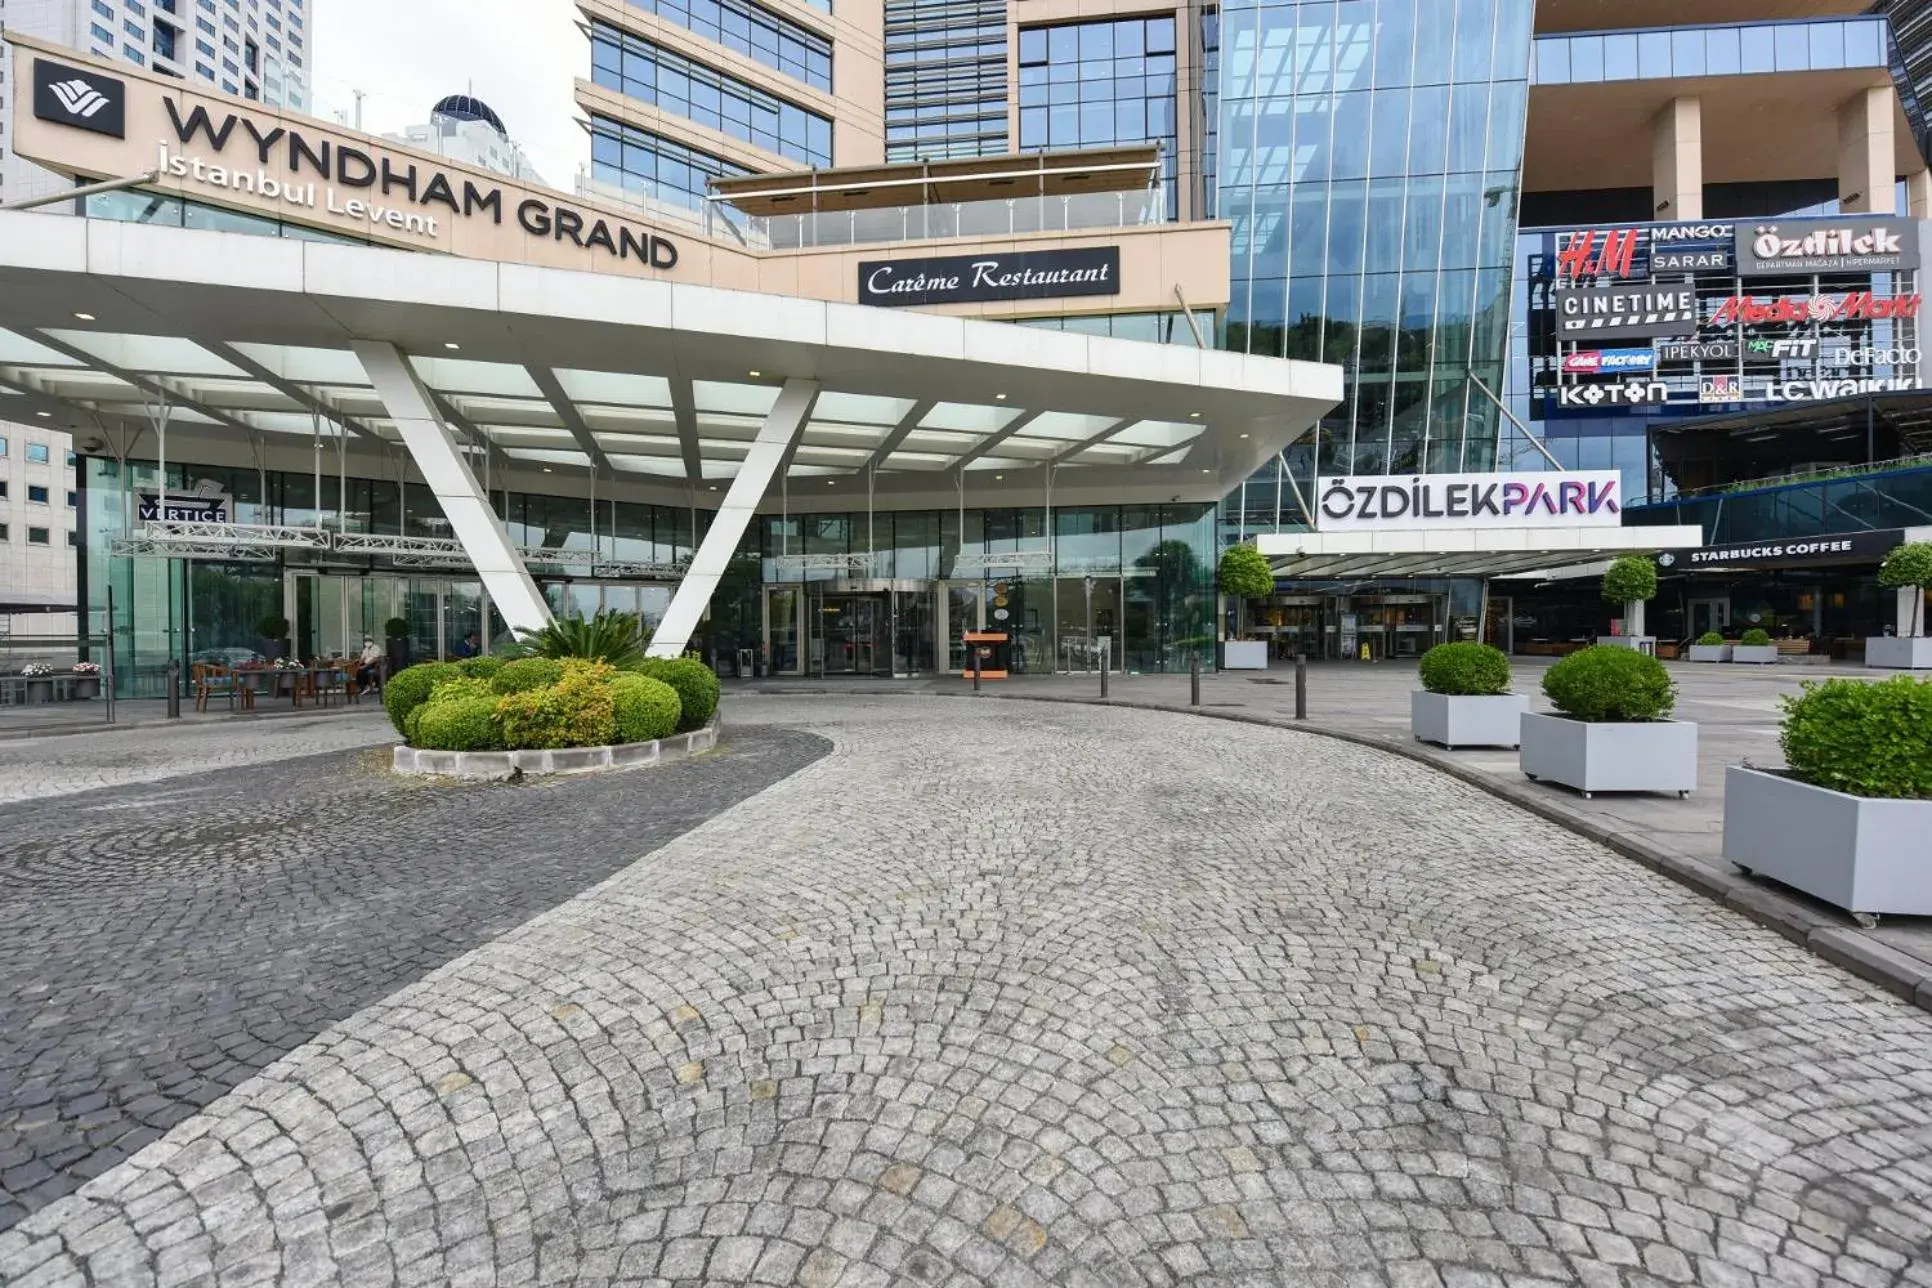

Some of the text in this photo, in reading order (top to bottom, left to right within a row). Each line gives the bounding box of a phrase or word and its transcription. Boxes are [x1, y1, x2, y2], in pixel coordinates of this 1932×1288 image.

[159, 140, 438, 238] İstanbul Levent
[163, 95, 679, 270] WYNDHAM GRAND
[1652, 225, 1725, 239] MANGO
[1753, 225, 1902, 259] Özdilek
[1558, 227, 1639, 279] H&M
[1654, 254, 1724, 268] SARAR
[867, 261, 1109, 294] Carême Restaurant
[1564, 292, 1691, 315] CINETIME
[1709, 291, 1922, 324] Media Markt
[1665, 344, 1732, 359] IPEKYOL
[1834, 347, 1922, 365] DeFacto
[1703, 381, 1739, 395] D&R
[1766, 381, 1805, 400] LC
[1321, 477, 1619, 519] ÖZDİLEKPARK
[1691, 540, 1852, 562] STARBUCKS COFFEE
